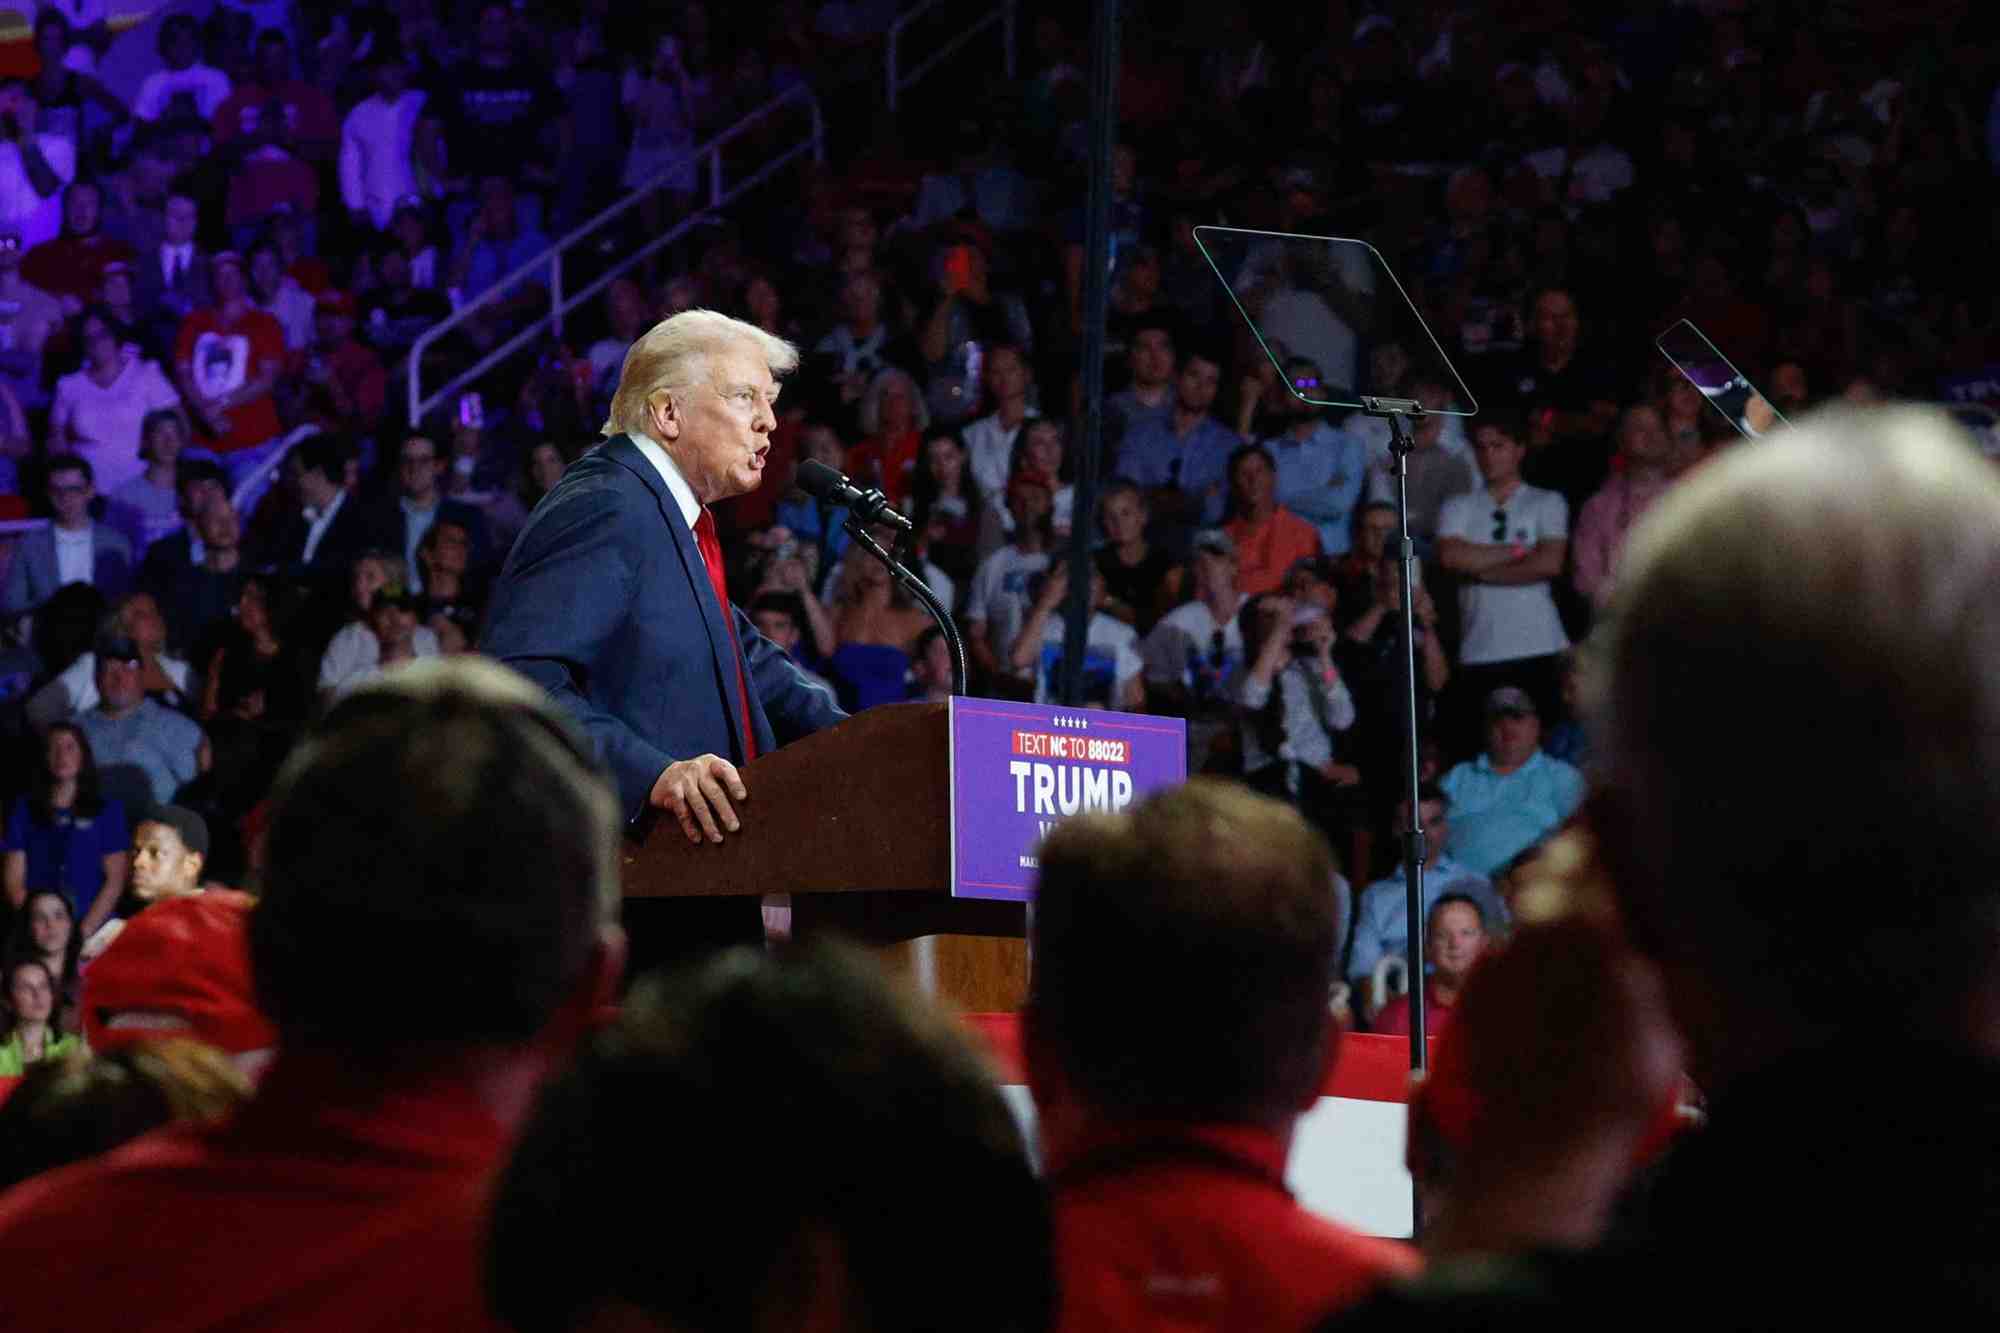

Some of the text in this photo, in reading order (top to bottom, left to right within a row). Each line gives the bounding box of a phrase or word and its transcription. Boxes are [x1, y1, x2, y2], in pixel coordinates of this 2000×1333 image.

[1018, 732, 1125, 762] TEXT NC TO 88022
[1010, 760, 1133, 817] TRUMP
